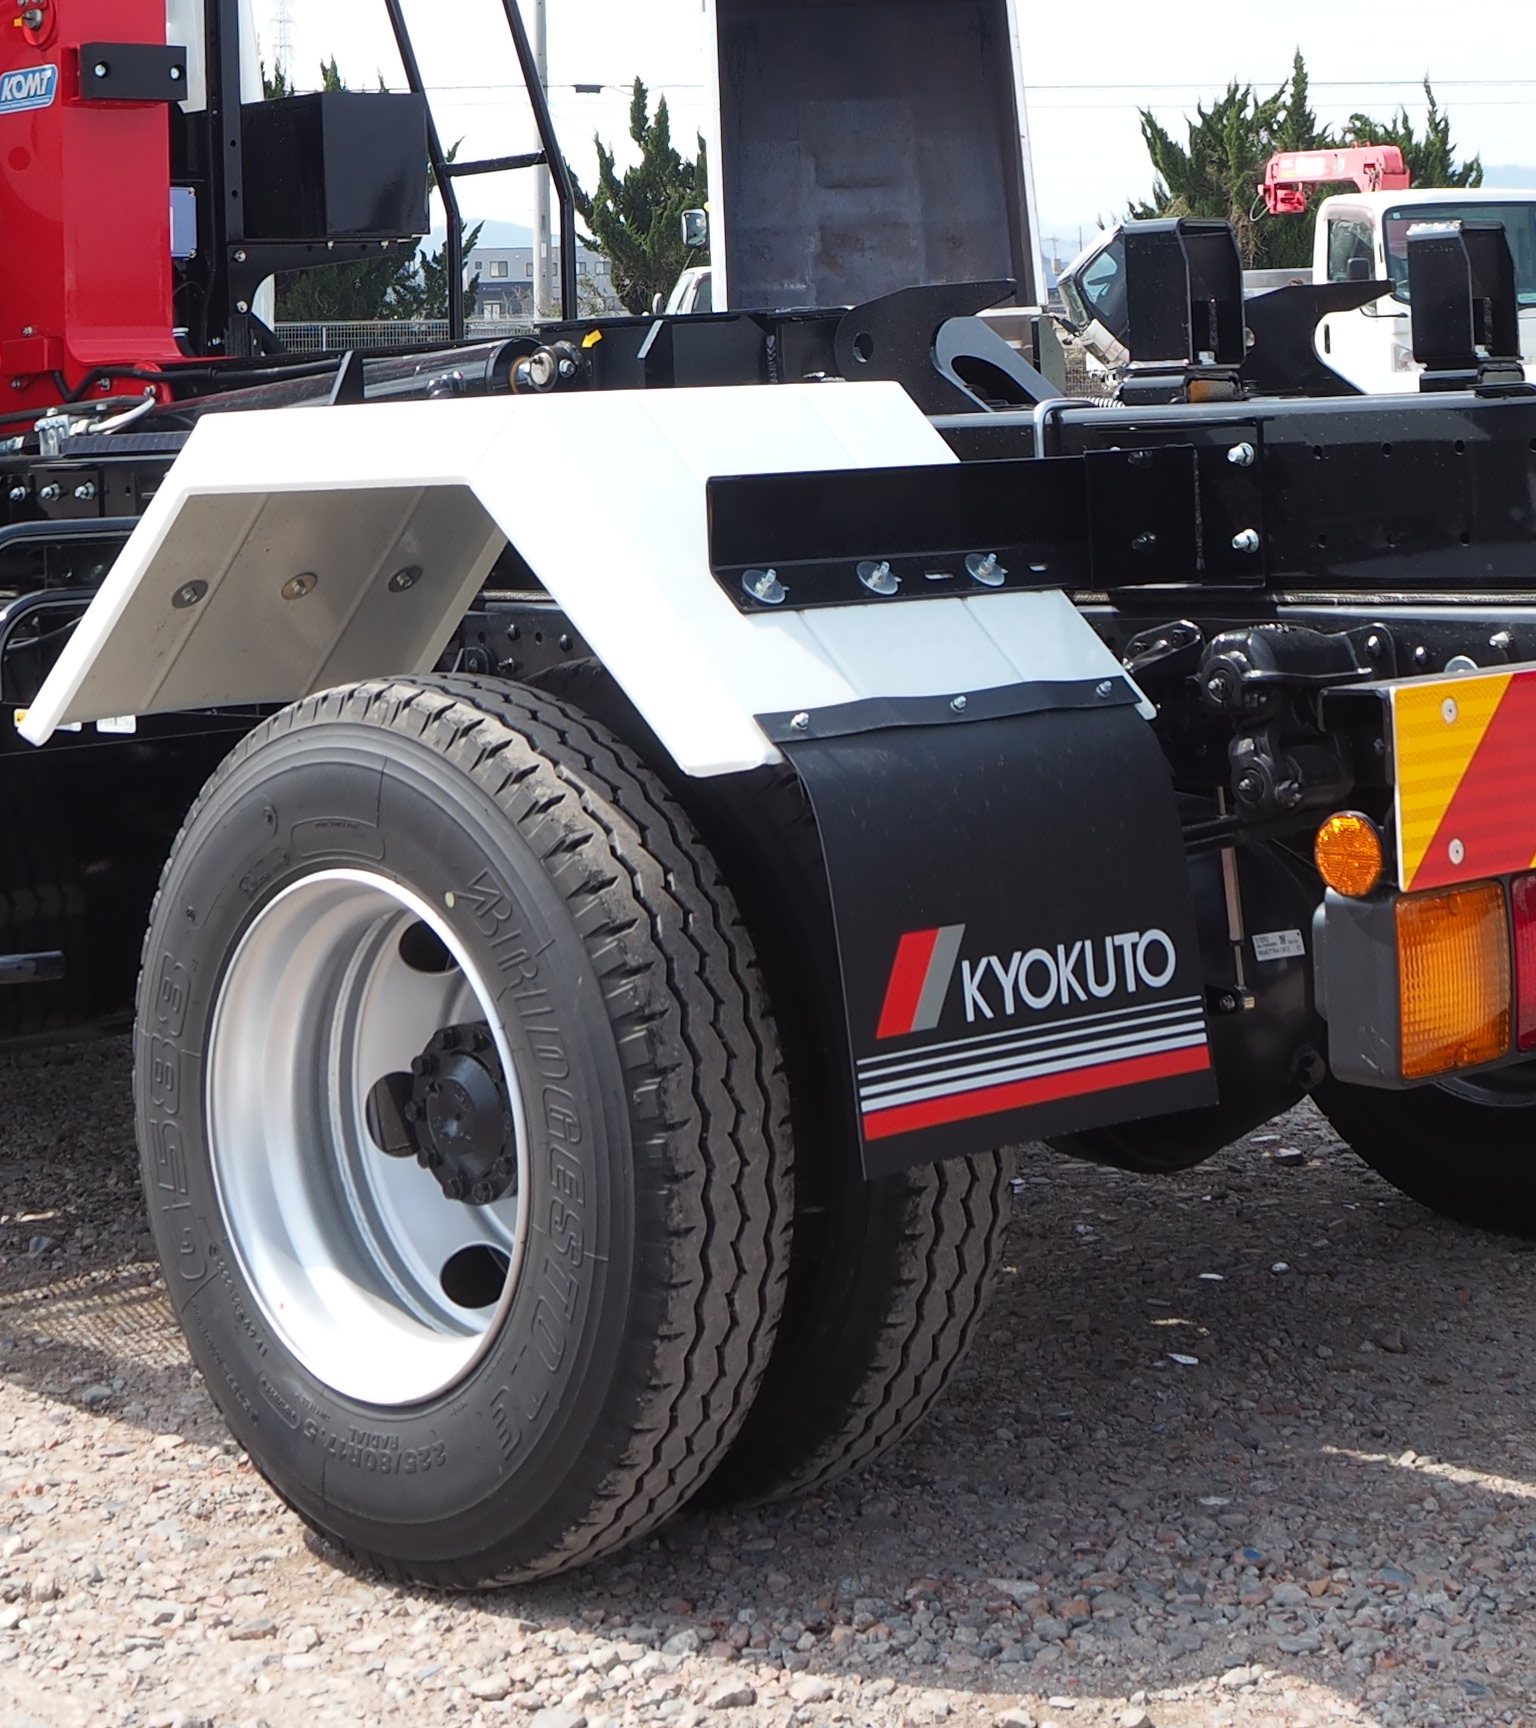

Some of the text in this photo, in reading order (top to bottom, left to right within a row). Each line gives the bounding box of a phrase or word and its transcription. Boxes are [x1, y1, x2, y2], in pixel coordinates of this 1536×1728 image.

[1, 69, 53, 102] KOMT
[961, 928, 1177, 1023] KYOKUTO
[303, 1418, 447, 1474] 225/80R17.5
[348, 1424, 400, 1451] RADIAL
